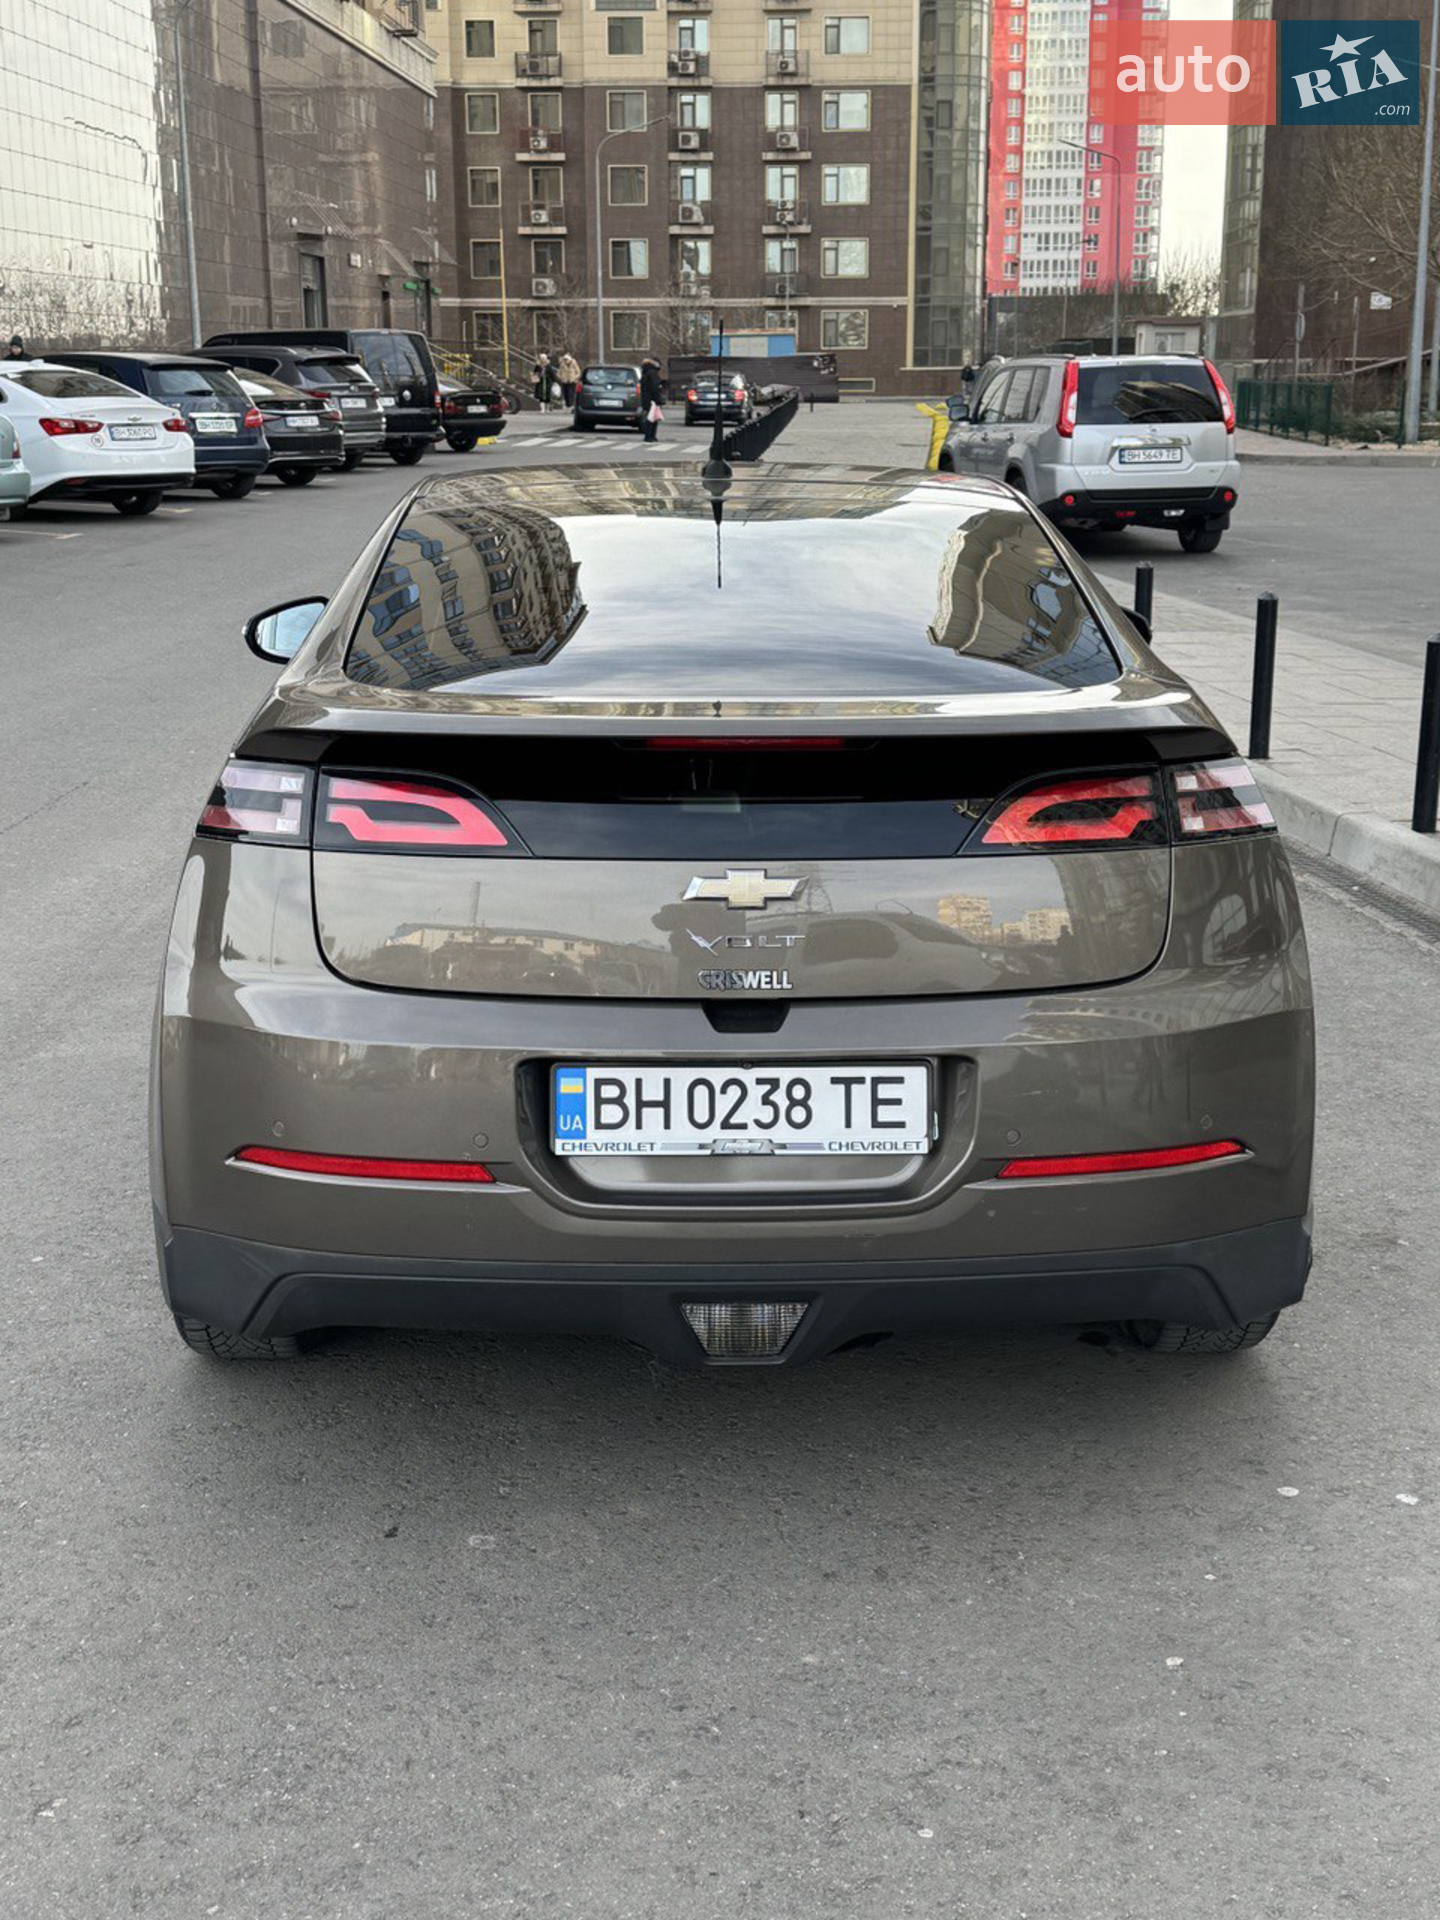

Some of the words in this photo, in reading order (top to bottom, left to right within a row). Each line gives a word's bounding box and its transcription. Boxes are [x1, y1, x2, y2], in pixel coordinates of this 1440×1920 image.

[1127, 451, 1141, 461] BH
[1142, 450, 1164, 461] 5649
[1165, 450, 1180, 460] TE
[685, 928, 806, 956] VOLT
[697, 968, 795, 991] CRISWELL
[593, 1077, 671, 1130] BH
[687, 1077, 813, 1130] 0238
[830, 1076, 907, 1129] TE
[560, 1114, 584, 1131] UA
[561, 1141, 658, 1152] CHEVROLET
[827, 1140, 923, 1152] CHEVROLET
